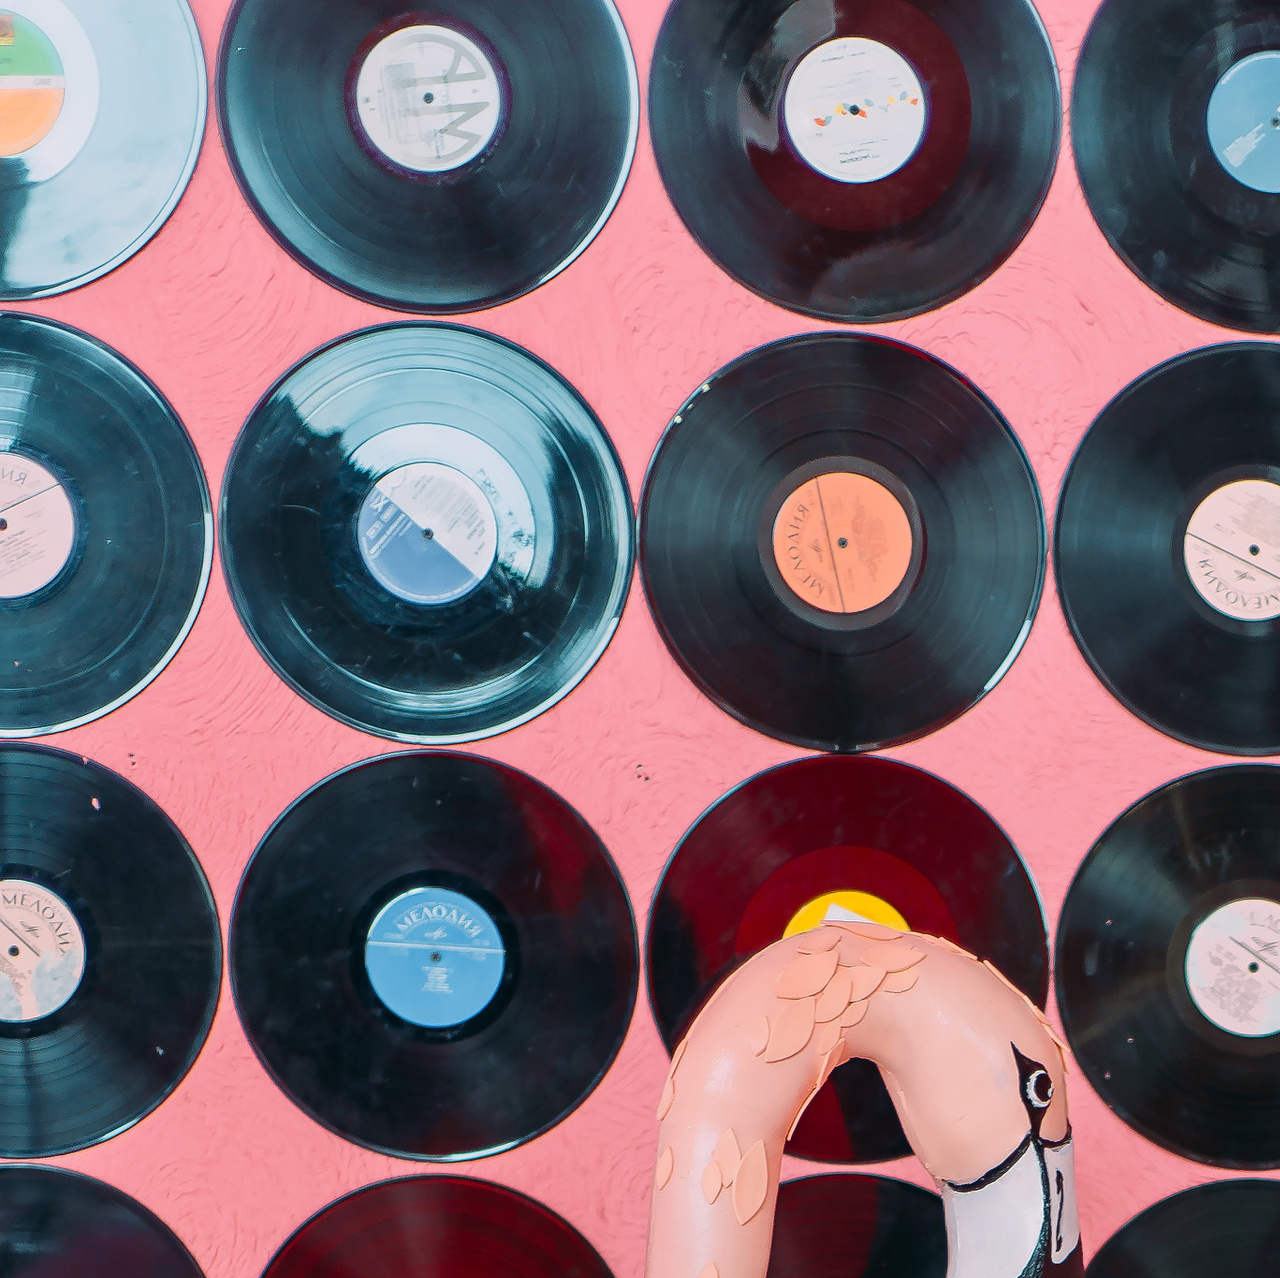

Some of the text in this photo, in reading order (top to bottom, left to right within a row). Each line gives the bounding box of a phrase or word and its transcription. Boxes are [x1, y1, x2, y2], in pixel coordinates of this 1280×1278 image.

[787, 502, 826, 598] МЕЛОДИЯ
[1198, 555, 1280, 612] МЕЛОДИЯ
[1, 892, 72, 957] МЕЛОДИ
[396, 903, 483, 937] МЕЛОДИЯ
